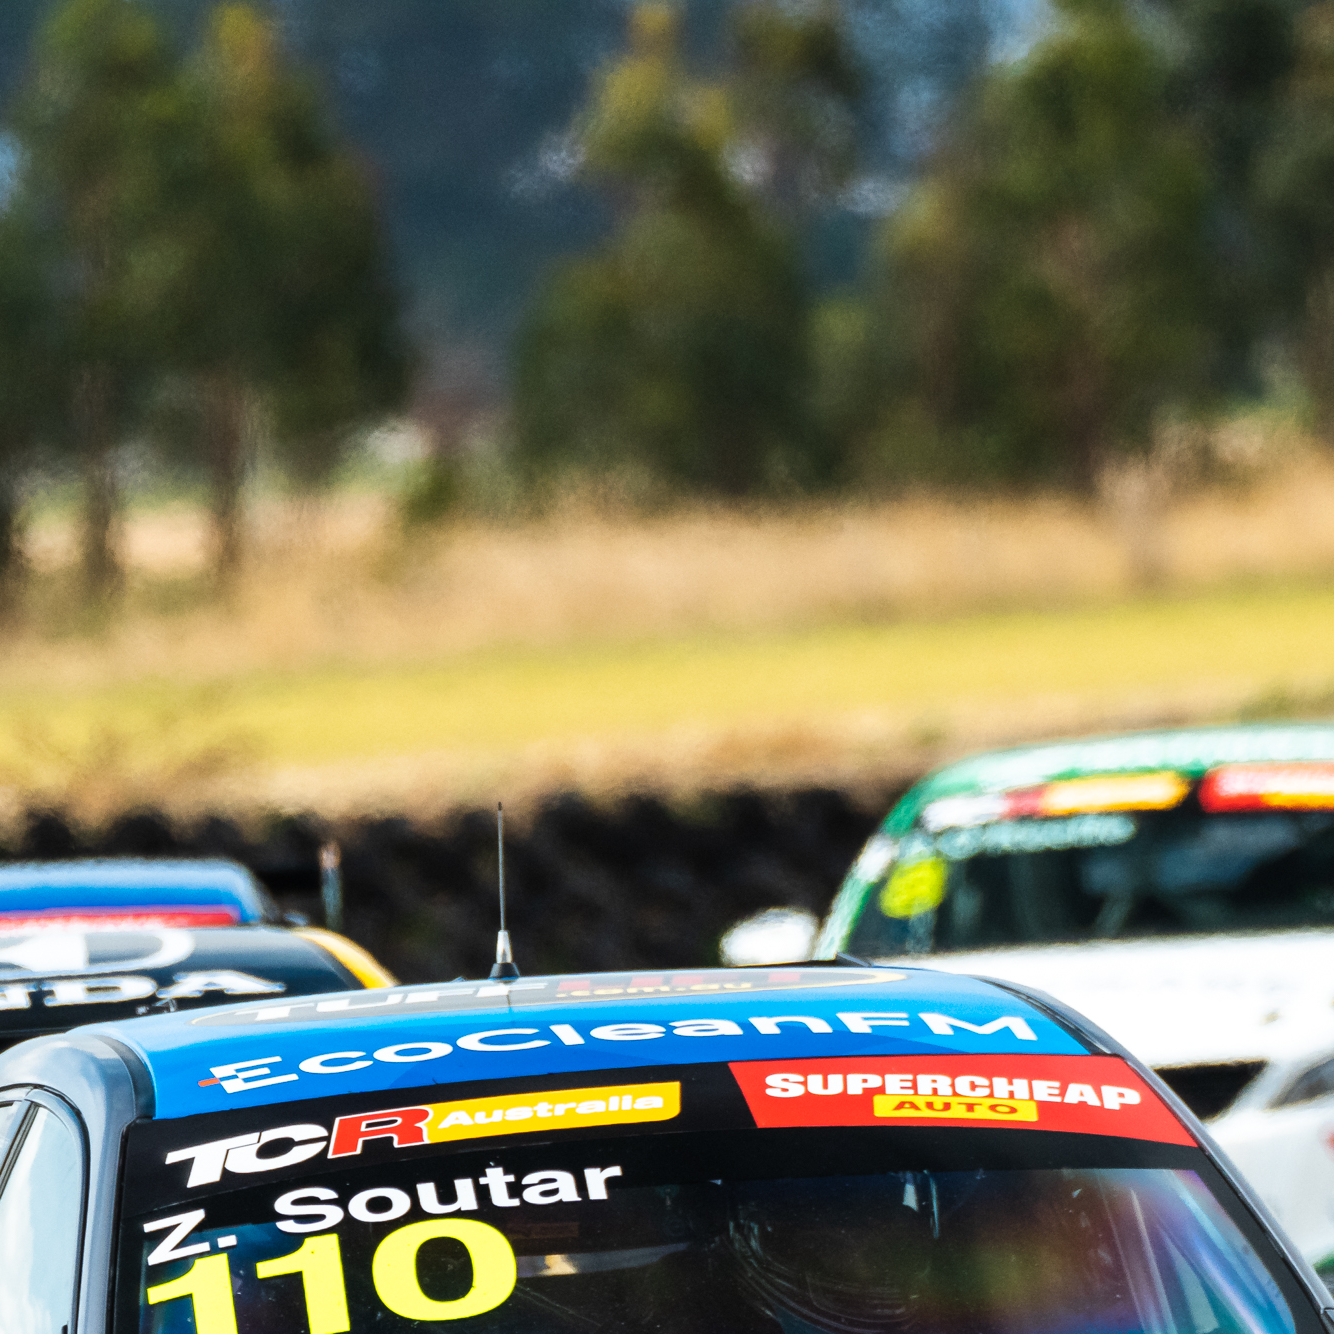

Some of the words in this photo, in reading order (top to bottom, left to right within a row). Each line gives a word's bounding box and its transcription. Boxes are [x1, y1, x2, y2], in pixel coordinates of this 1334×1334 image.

[208, 1012, 1039, 1094] EcoCleanFM
[764, 1072, 1141, 1111] SUPERCHEAP
[164, 1106, 433, 1188] TCR
[438, 1091, 664, 1129] Australia
[891, 1099, 1019, 1115] AUTO
[143, 1208, 239, 1267] Z.
[273, 1162, 624, 1234] Soutar
